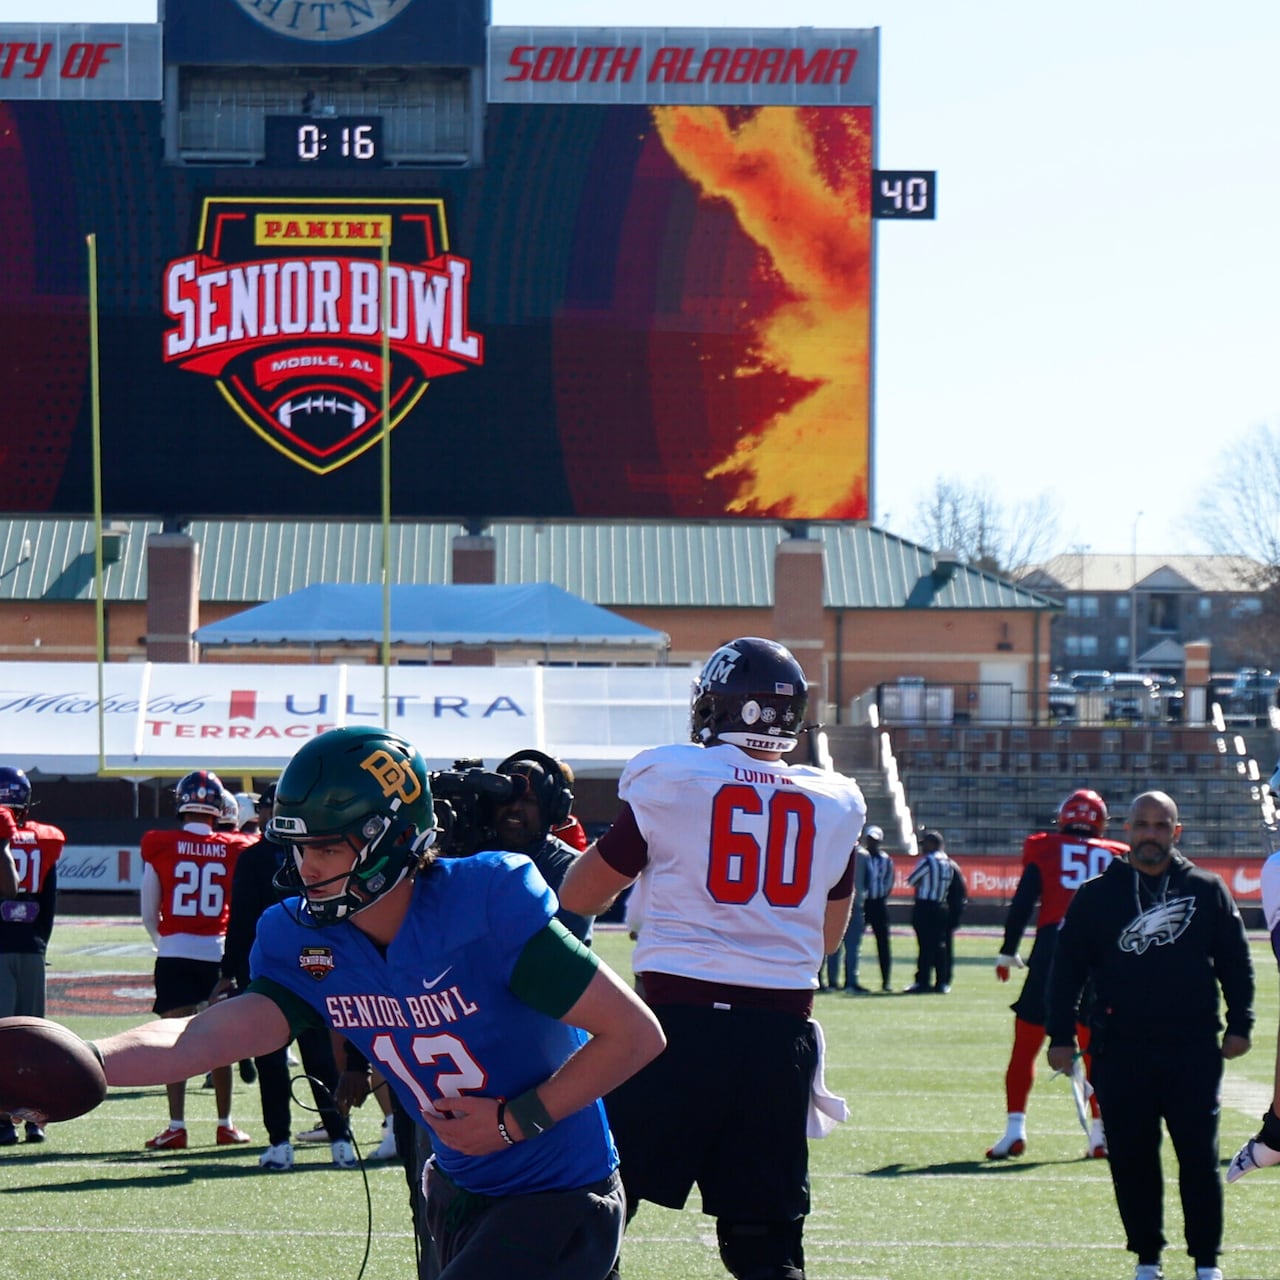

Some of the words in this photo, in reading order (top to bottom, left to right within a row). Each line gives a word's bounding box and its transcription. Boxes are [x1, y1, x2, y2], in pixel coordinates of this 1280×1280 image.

[60, 42, 122, 79] OF
[504, 46, 642, 83] SOUTH
[648, 46, 858, 84] ALABAMA
[297, 124, 375, 160] 0:16
[880, 177, 928, 212] 40
[264, 220, 383, 240] PANINI
[167, 259, 342, 357] SENIOR
[348, 259, 480, 359] BOWL
[271, 355, 345, 373] MOBILE,
[350, 358, 374, 373] AL
[284, 693, 528, 719] ULTRA
[745, 738, 776, 750] TEXAS
[359, 749, 423, 805] BU
[177, 840, 228, 858] WILLIAMS
[706, 784, 817, 908] 60
[972, 870, 1020, 892] Powe
[1060, 843, 1114, 890] 50
[172, 860, 227, 917] 26
[325, 995, 410, 1028] SENIOR
[405, 984, 480, 1029] BOWL
[371, 1030, 489, 1110] 12
